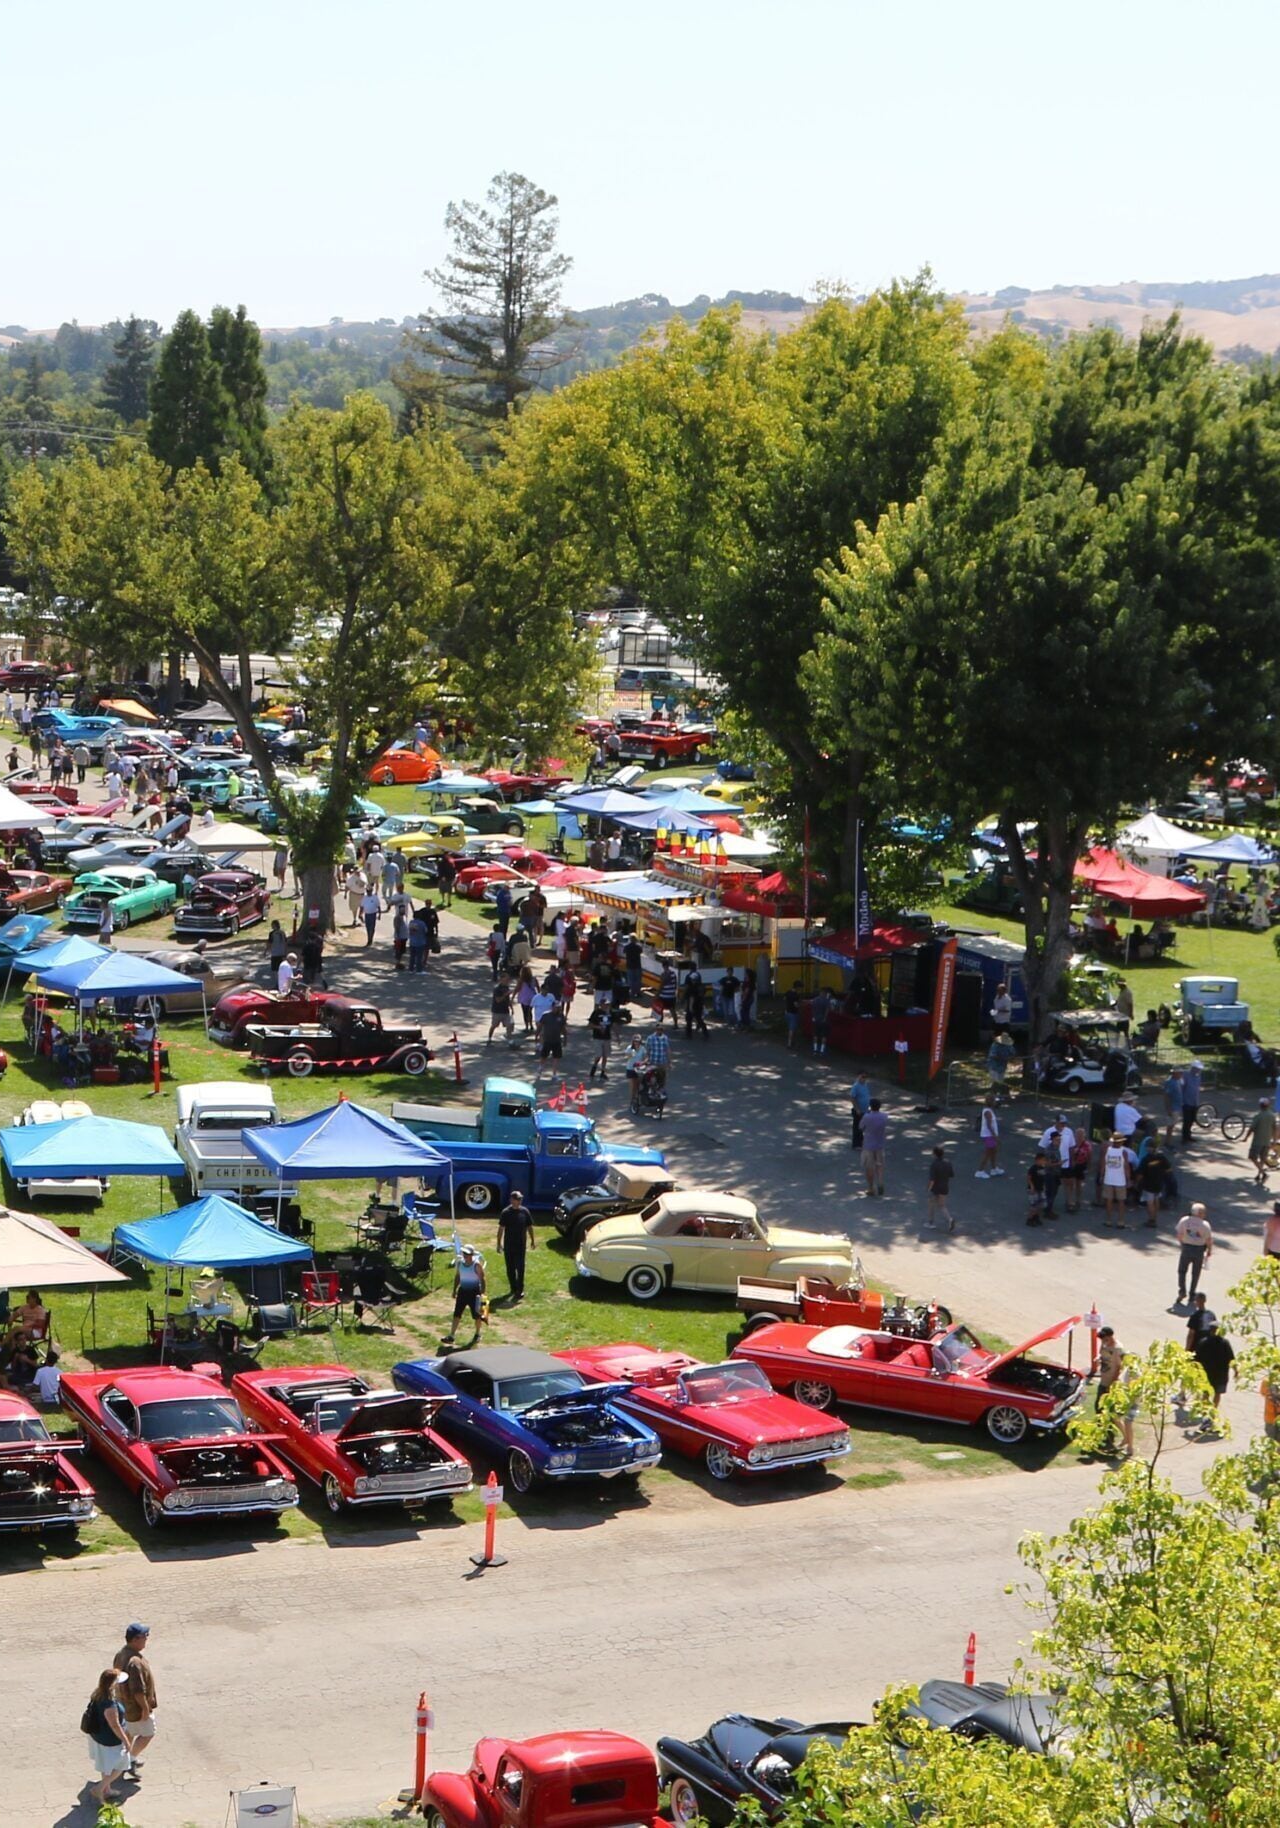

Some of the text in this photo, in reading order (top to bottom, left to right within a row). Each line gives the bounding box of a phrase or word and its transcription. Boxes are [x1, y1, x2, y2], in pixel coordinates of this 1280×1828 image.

[859, 890, 870, 935] Modelo
[934, 1031, 943, 1062] NITRO
[216, 1168, 273, 1177] CHEROLE
